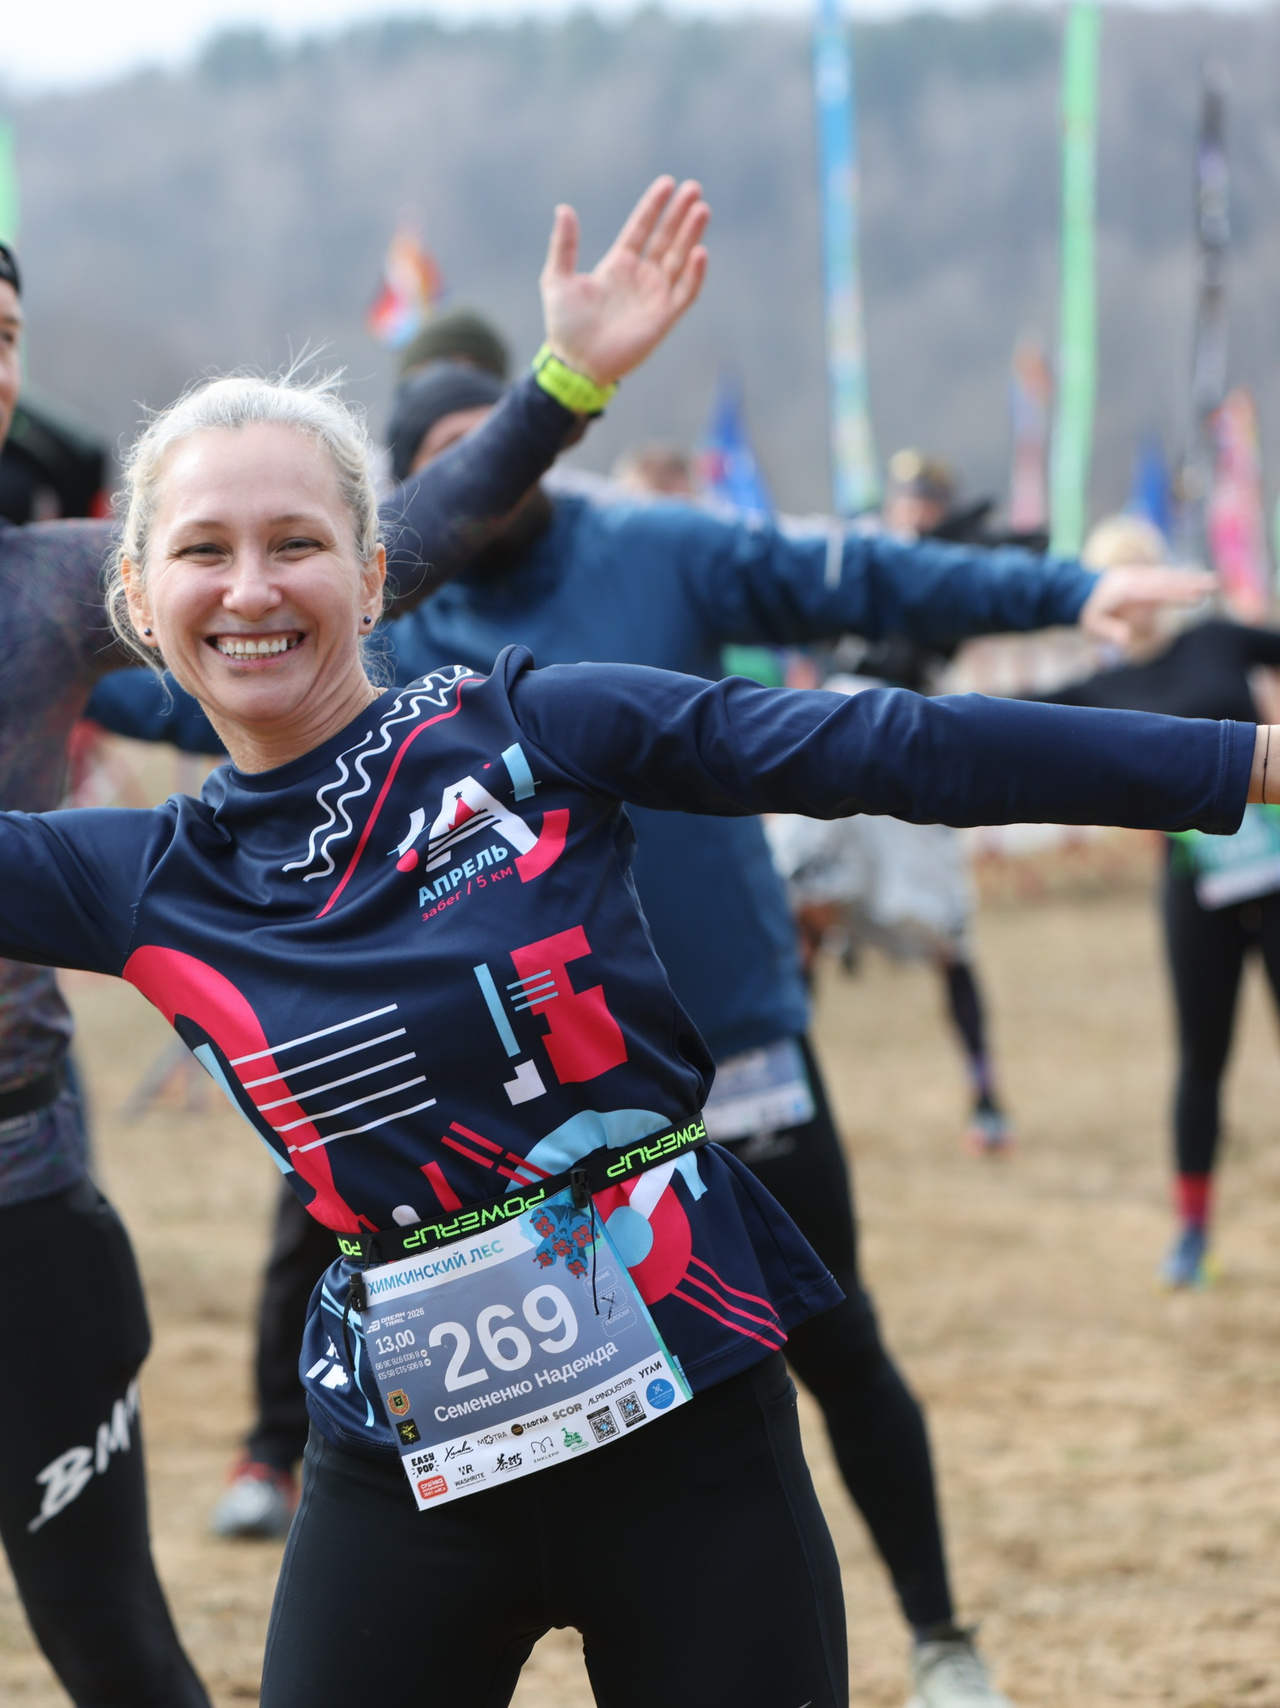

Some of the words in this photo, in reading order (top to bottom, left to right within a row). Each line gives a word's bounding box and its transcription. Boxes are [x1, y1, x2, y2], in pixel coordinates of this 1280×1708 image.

[419, 844, 508, 908] АПРЕЛЬ
[422, 890, 462, 921] забег
[476, 875, 487, 888] 5
[491, 866, 513, 883] км
[606, 1119, 706, 1178] POWERUP
[402, 1188, 546, 1249] POWERUP
[368, 1251, 467, 1295] ХИМКИНСКИЙ
[470, 1240, 504, 1263] ЛЕС
[380, 1311, 405, 1324] DREAM
[385, 1317, 405, 1328] TRAIL
[407, 1307, 425, 1320] 2026
[375, 1329, 415, 1355] 13,00
[428, 1284, 578, 1392] 269
[638, 1361, 662, 1378] УГЛИ
[434, 1381, 533, 1422] Семененко
[534, 1342, 619, 1388] Надежда
[587, 1377, 636, 1406] ALPINDUSTRIA
[552, 1403, 583, 1420] SCOR
[523, 1415, 549, 1430] ТАФГАЙ
[411, 1452, 435, 1467] EASY
[417, 1462, 435, 1475] POP
[454, 1472, 485, 1487] WASHRITE
